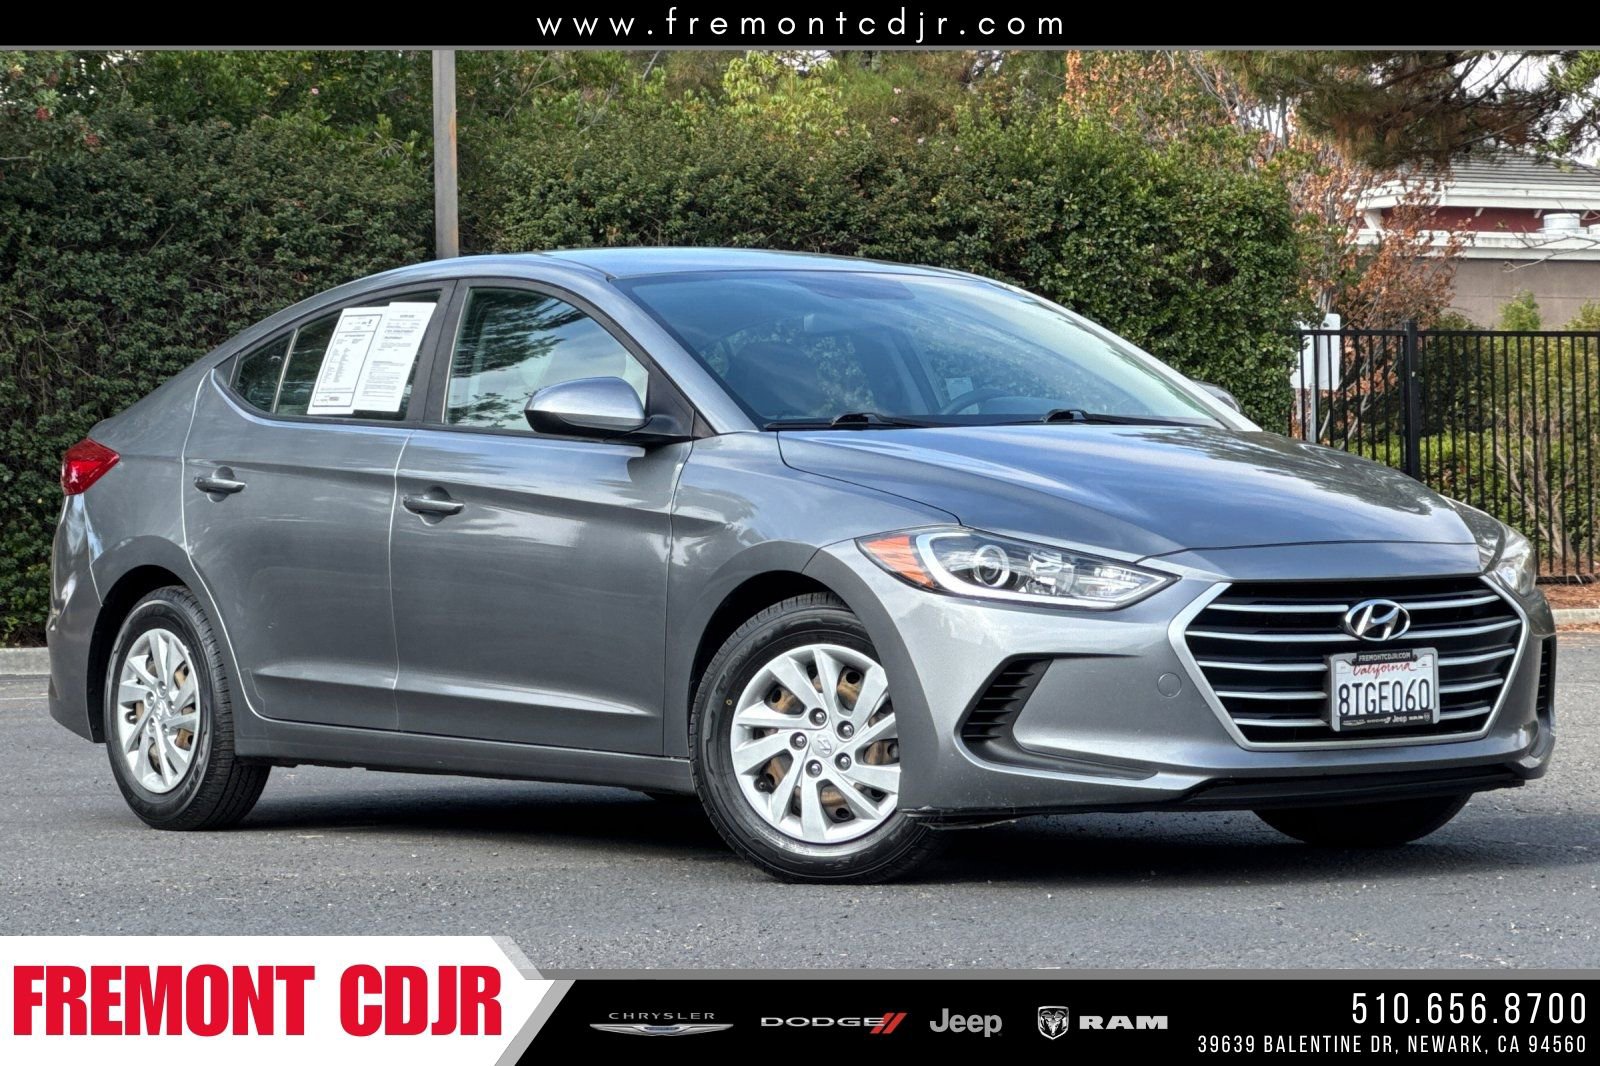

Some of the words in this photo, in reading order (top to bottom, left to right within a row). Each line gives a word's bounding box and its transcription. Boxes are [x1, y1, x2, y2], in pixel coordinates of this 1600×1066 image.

[1358, 652, 1411, 662] FREMONTCDJR.COM
[1352, 662, 1417, 679] California
[1338, 678, 1430, 717] 8TGE060
